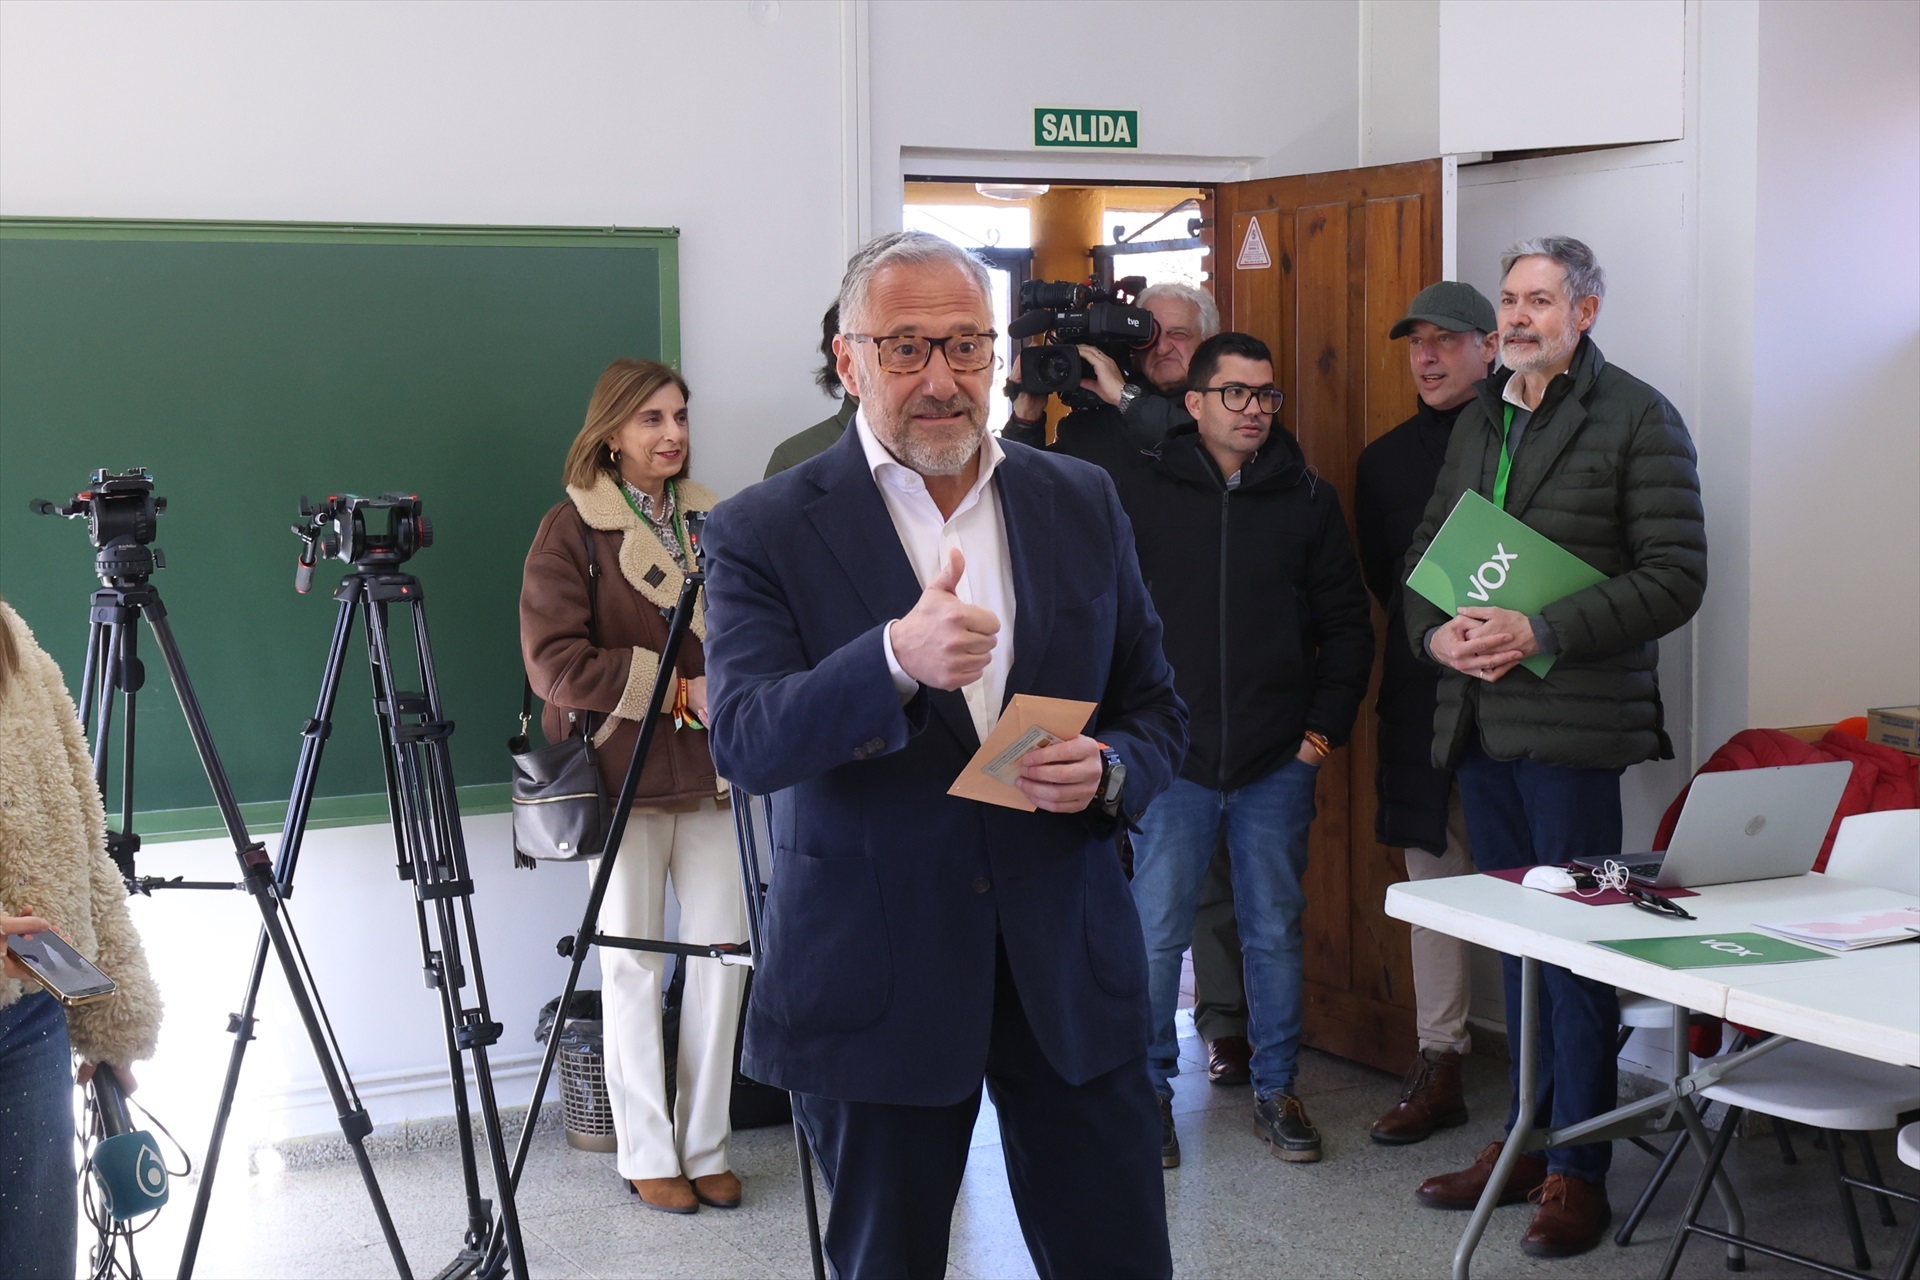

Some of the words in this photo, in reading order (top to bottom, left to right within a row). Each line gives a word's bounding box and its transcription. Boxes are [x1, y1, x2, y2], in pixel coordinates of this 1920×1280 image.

[1042, 113, 1131, 143] SALIDA
[1127, 316, 1140, 328] tve
[1466, 542, 1519, 602] VOX
[1699, 939, 1764, 957] VOX
